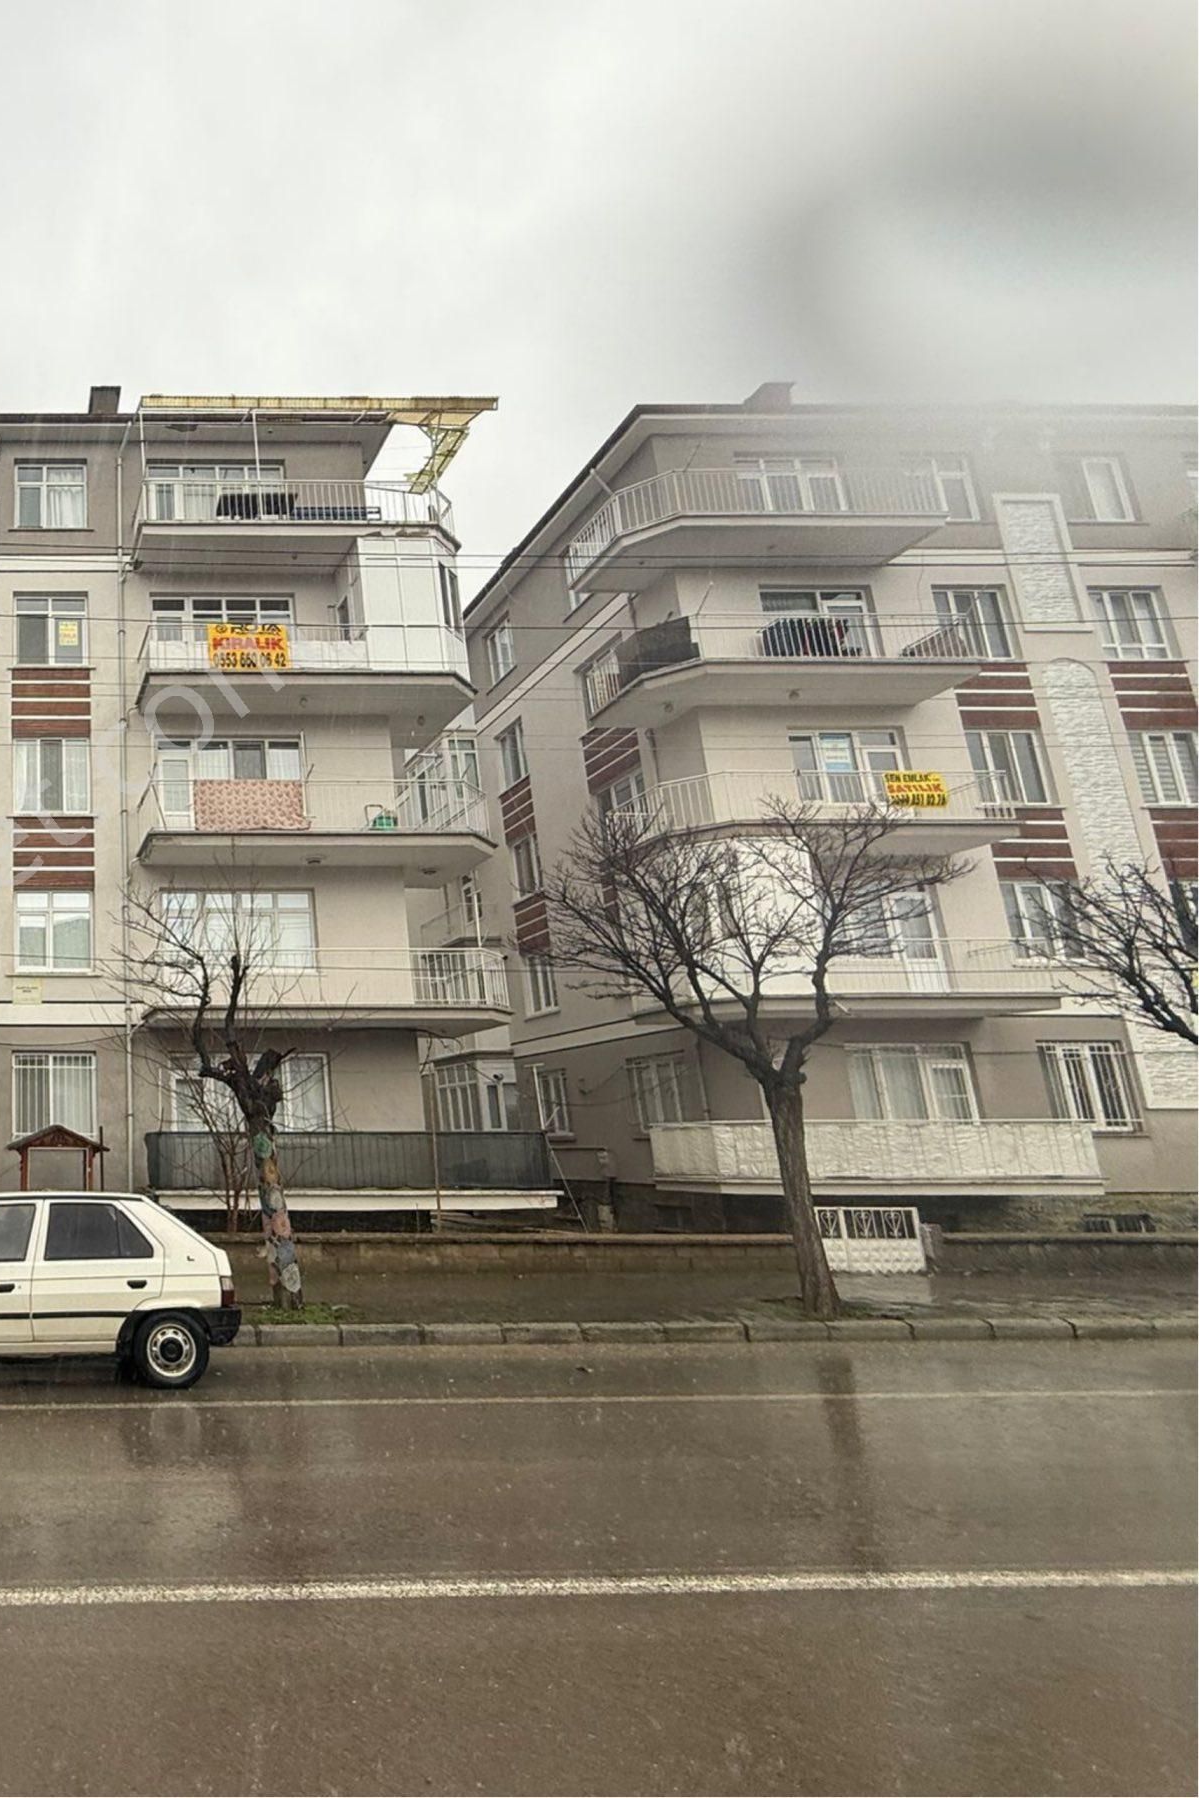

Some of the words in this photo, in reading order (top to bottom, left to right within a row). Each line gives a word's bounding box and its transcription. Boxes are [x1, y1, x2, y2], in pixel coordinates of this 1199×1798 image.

[212, 637, 285, 650] KIRALIK
[274, 652, 287, 667] 42
[887, 784, 943, 793] SATILIK
